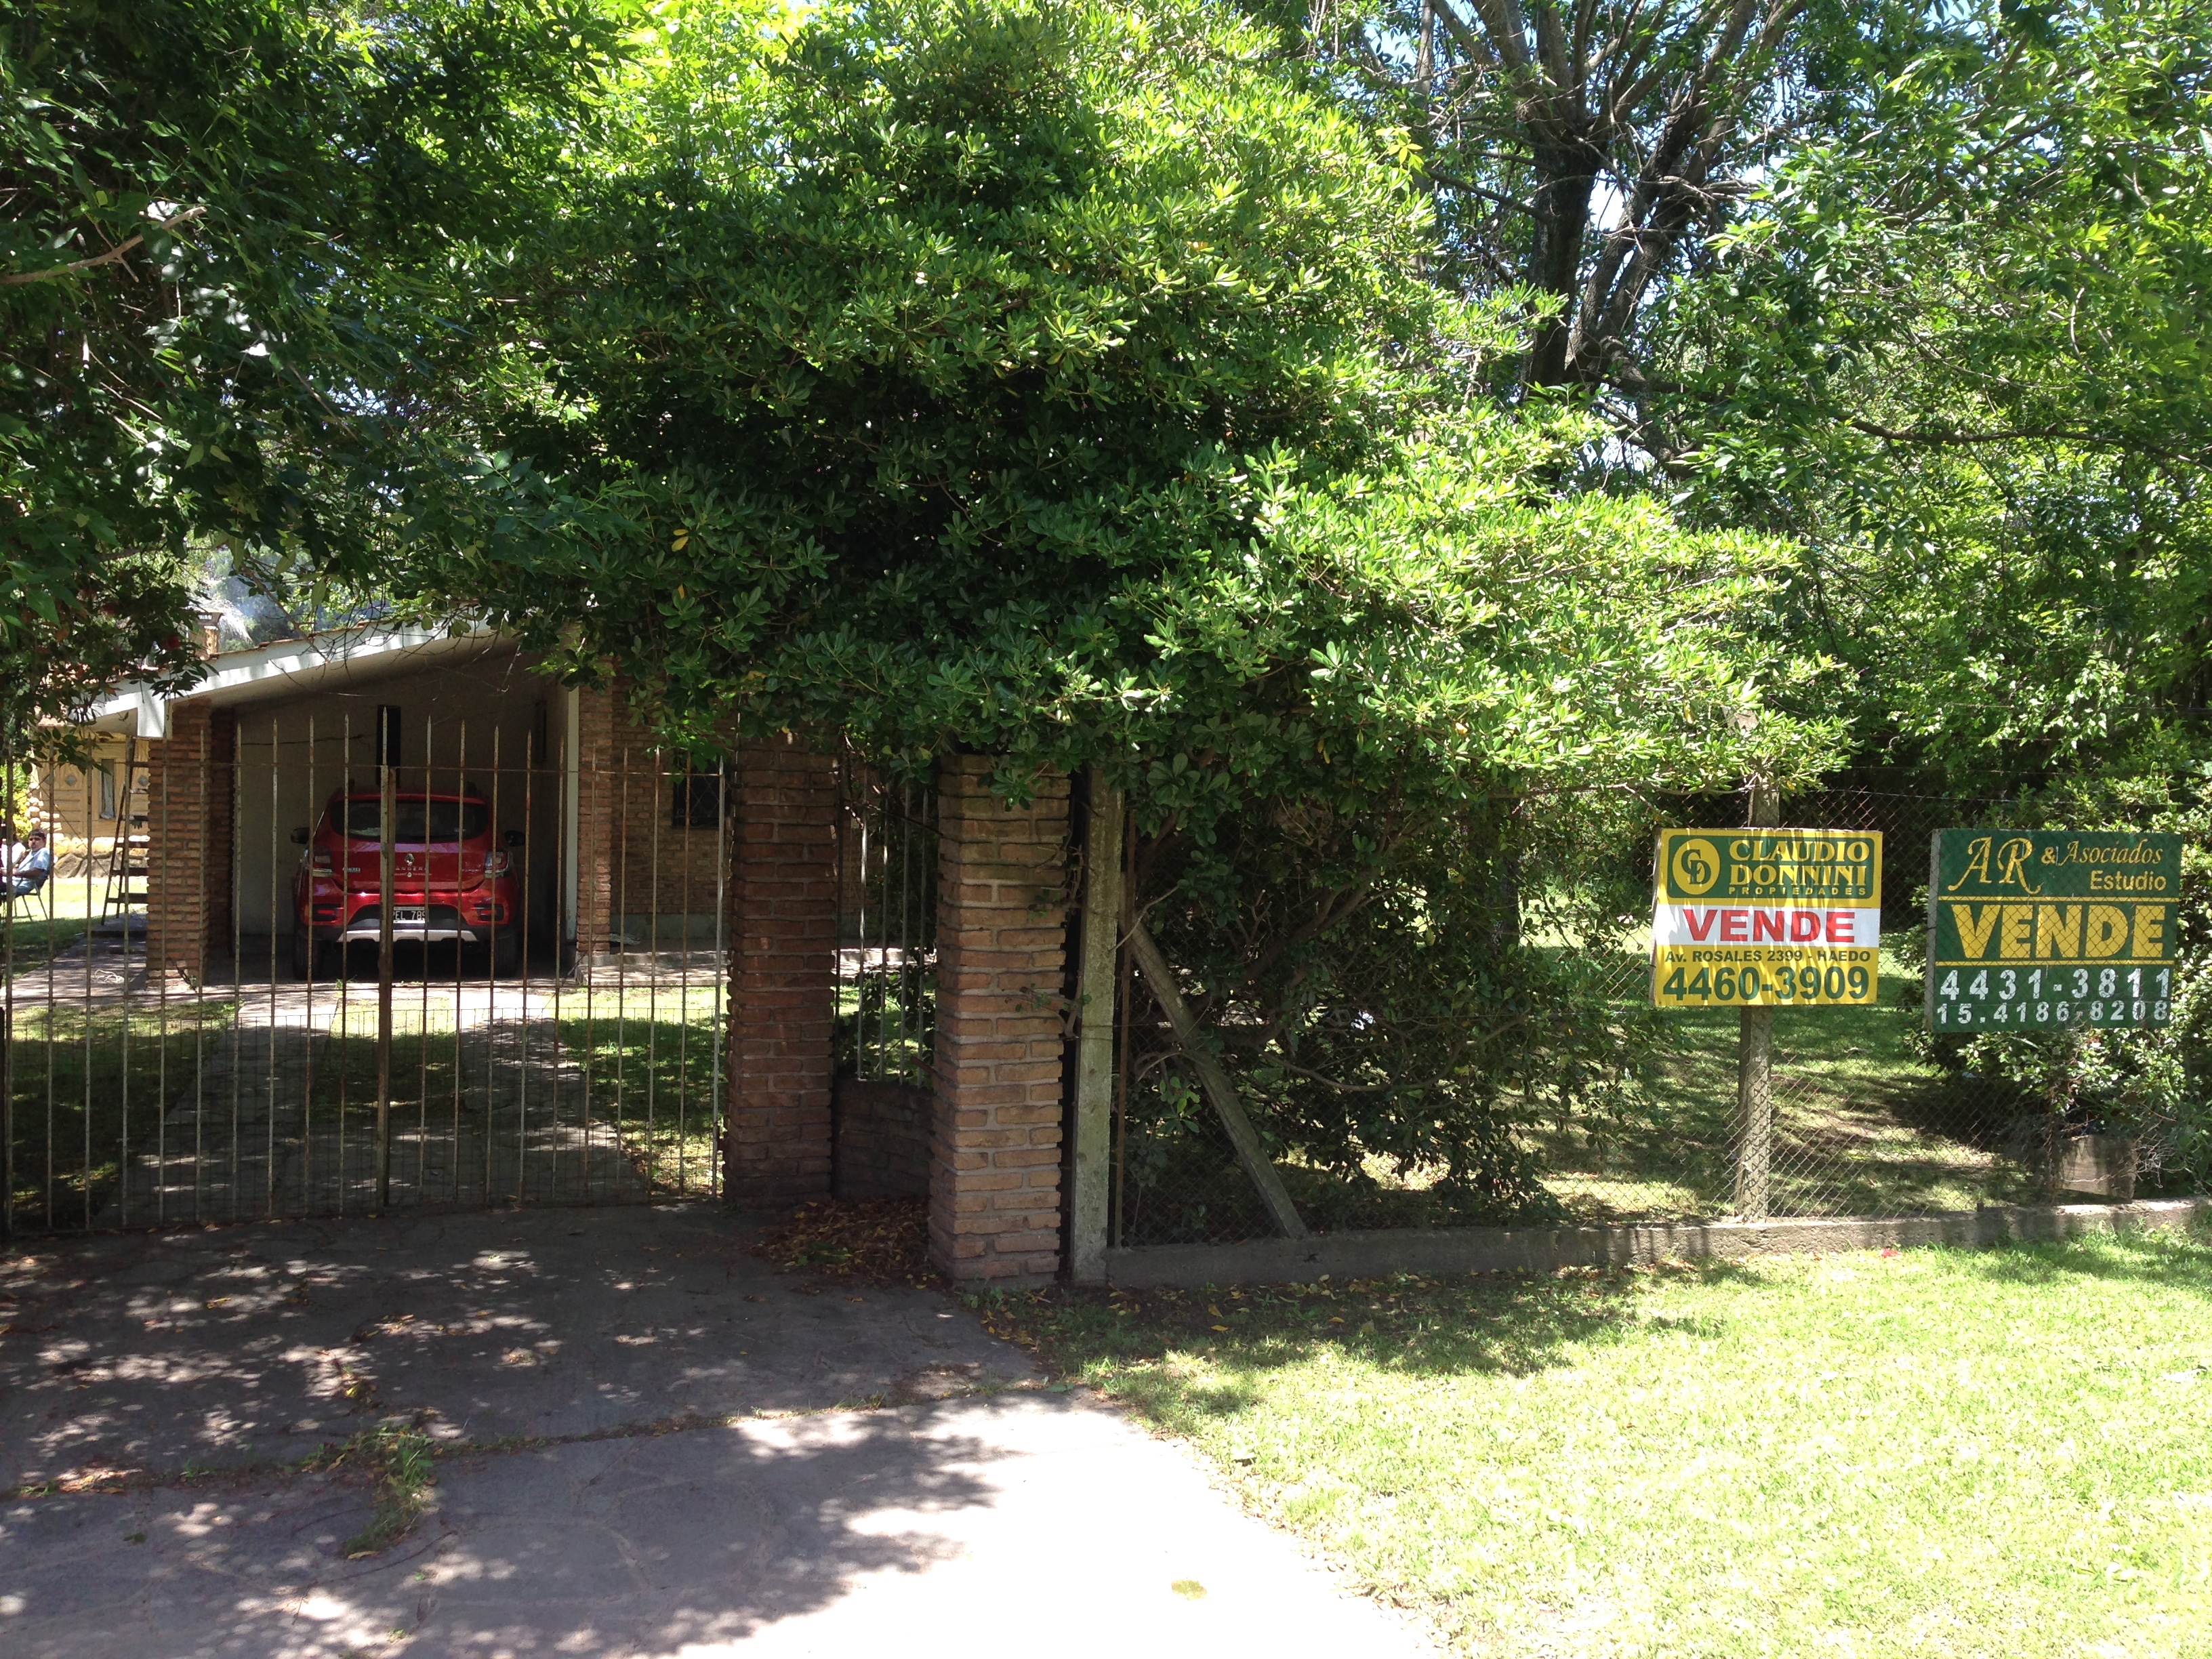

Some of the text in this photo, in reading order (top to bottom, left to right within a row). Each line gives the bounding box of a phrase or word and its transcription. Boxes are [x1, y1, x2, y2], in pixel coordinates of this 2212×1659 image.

[1729, 840, 1870, 863] CLAUDIO
[1729, 864, 1867, 886] DONNINI
[1948, 835, 2163, 895] AR & Asociados
[1729, 886, 1866, 895] PROPIEDADES
[2090, 870, 2167, 891] Estudio
[394, 911, 406, 920] EL
[1682, 909, 1856, 943] VENDE
[1951, 904, 2166, 959] VENDE
[1664, 950, 1687, 963] Av.
[1692, 950, 1762, 962] ROSALES
[1767, 950, 1803, 962] 2399
[1818, 950, 1870, 962] HAEDO
[1663, 966, 1869, 1001] 4460-3909
[1940, 968, 2169, 1001] 4431-3811
